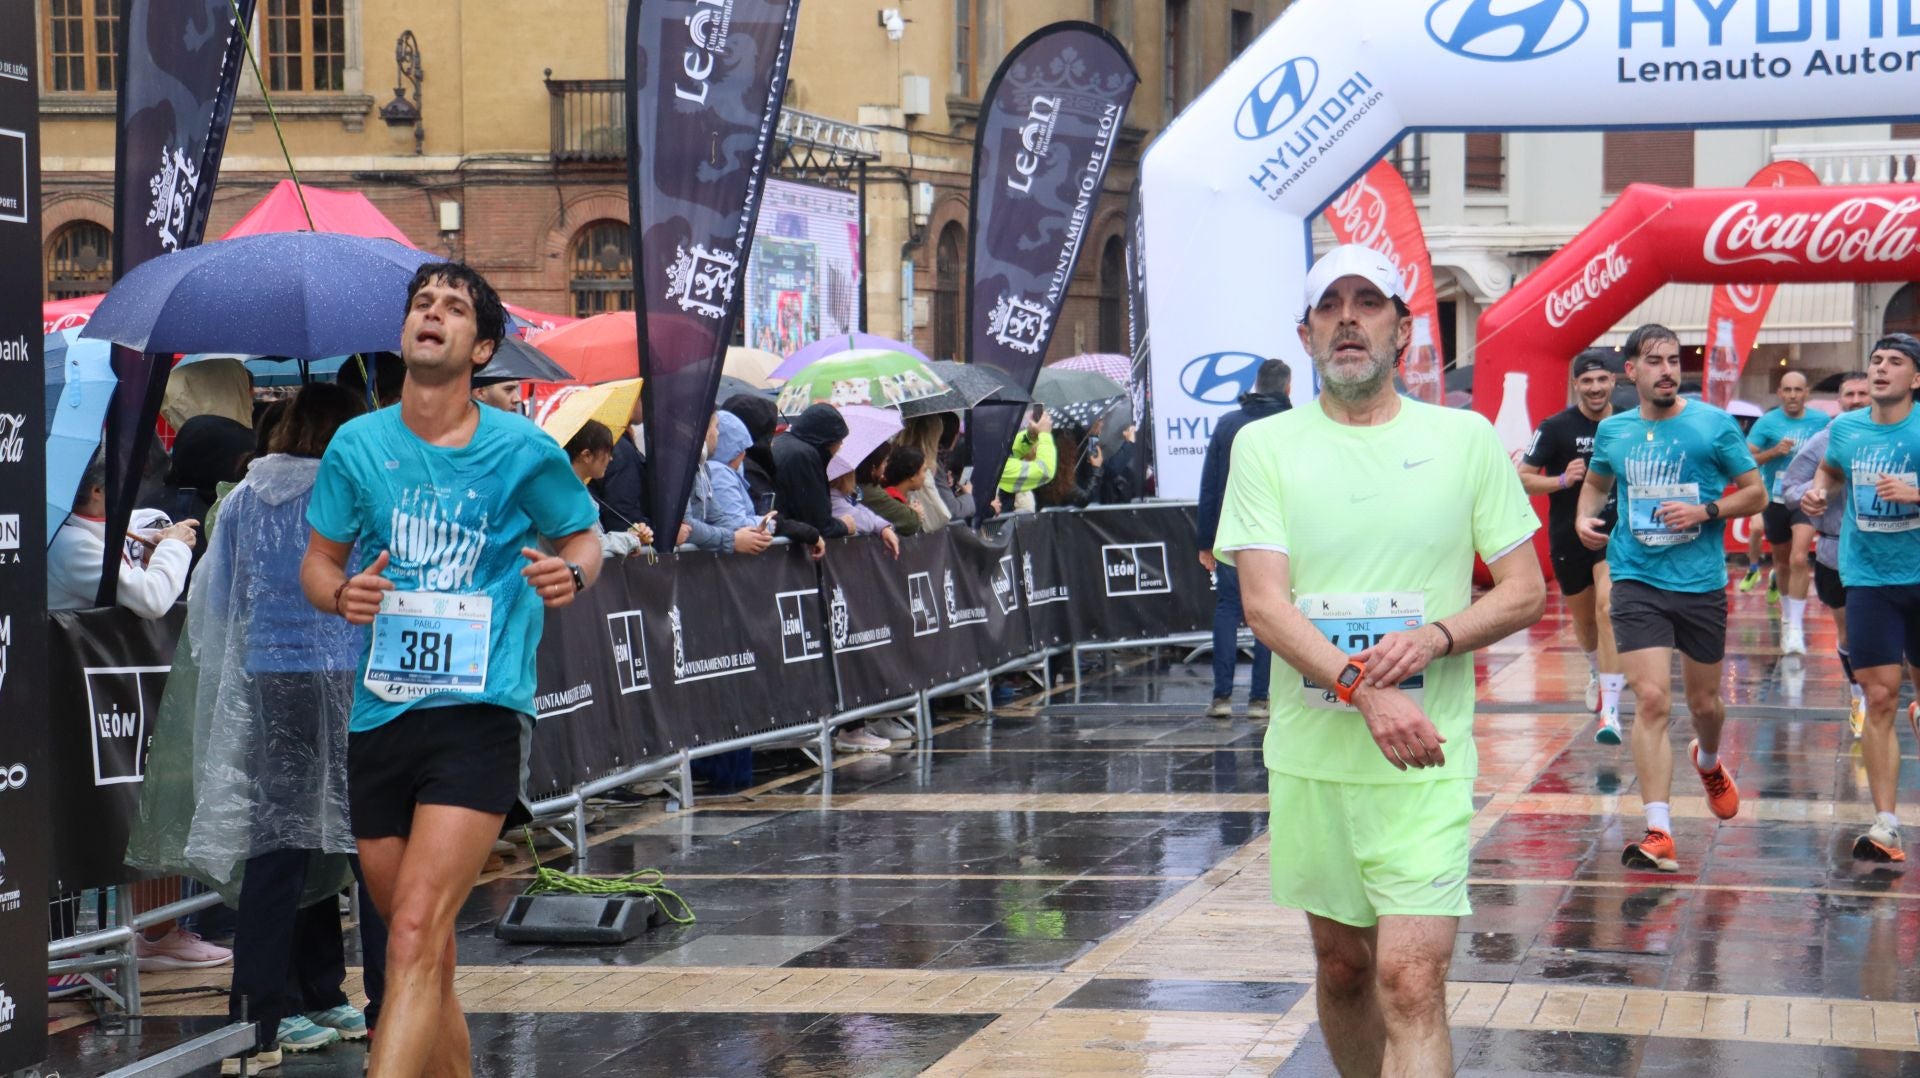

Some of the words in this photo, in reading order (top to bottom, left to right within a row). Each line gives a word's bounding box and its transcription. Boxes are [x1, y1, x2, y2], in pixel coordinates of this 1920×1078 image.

[1617, 53, 1792, 83] Lemauto
[1249, 71, 1373, 192] HYUNDAI
[1268, 155, 1318, 201] Lemauto
[1317, 90, 1384, 157] Automoción
[1047, 176, 1095, 304] AYUNTAMIENTO
[1087, 150, 1103, 174] DE
[1095, 104, 1117, 147] LEÓN
[1703, 196, 1920, 265] Coca-Cola
[1545, 242, 1630, 328] Coca-Cola
[1108, 559, 1135, 577] LEÓN
[414, 619, 441, 630] PABLO
[1346, 622, 1371, 632] TONI
[399, 630, 453, 673] 381
[683, 655, 731, 676] AYUNTAMIENTO
[739, 649, 756, 666] LEÓN
[98, 703, 137, 738] LEÓN
